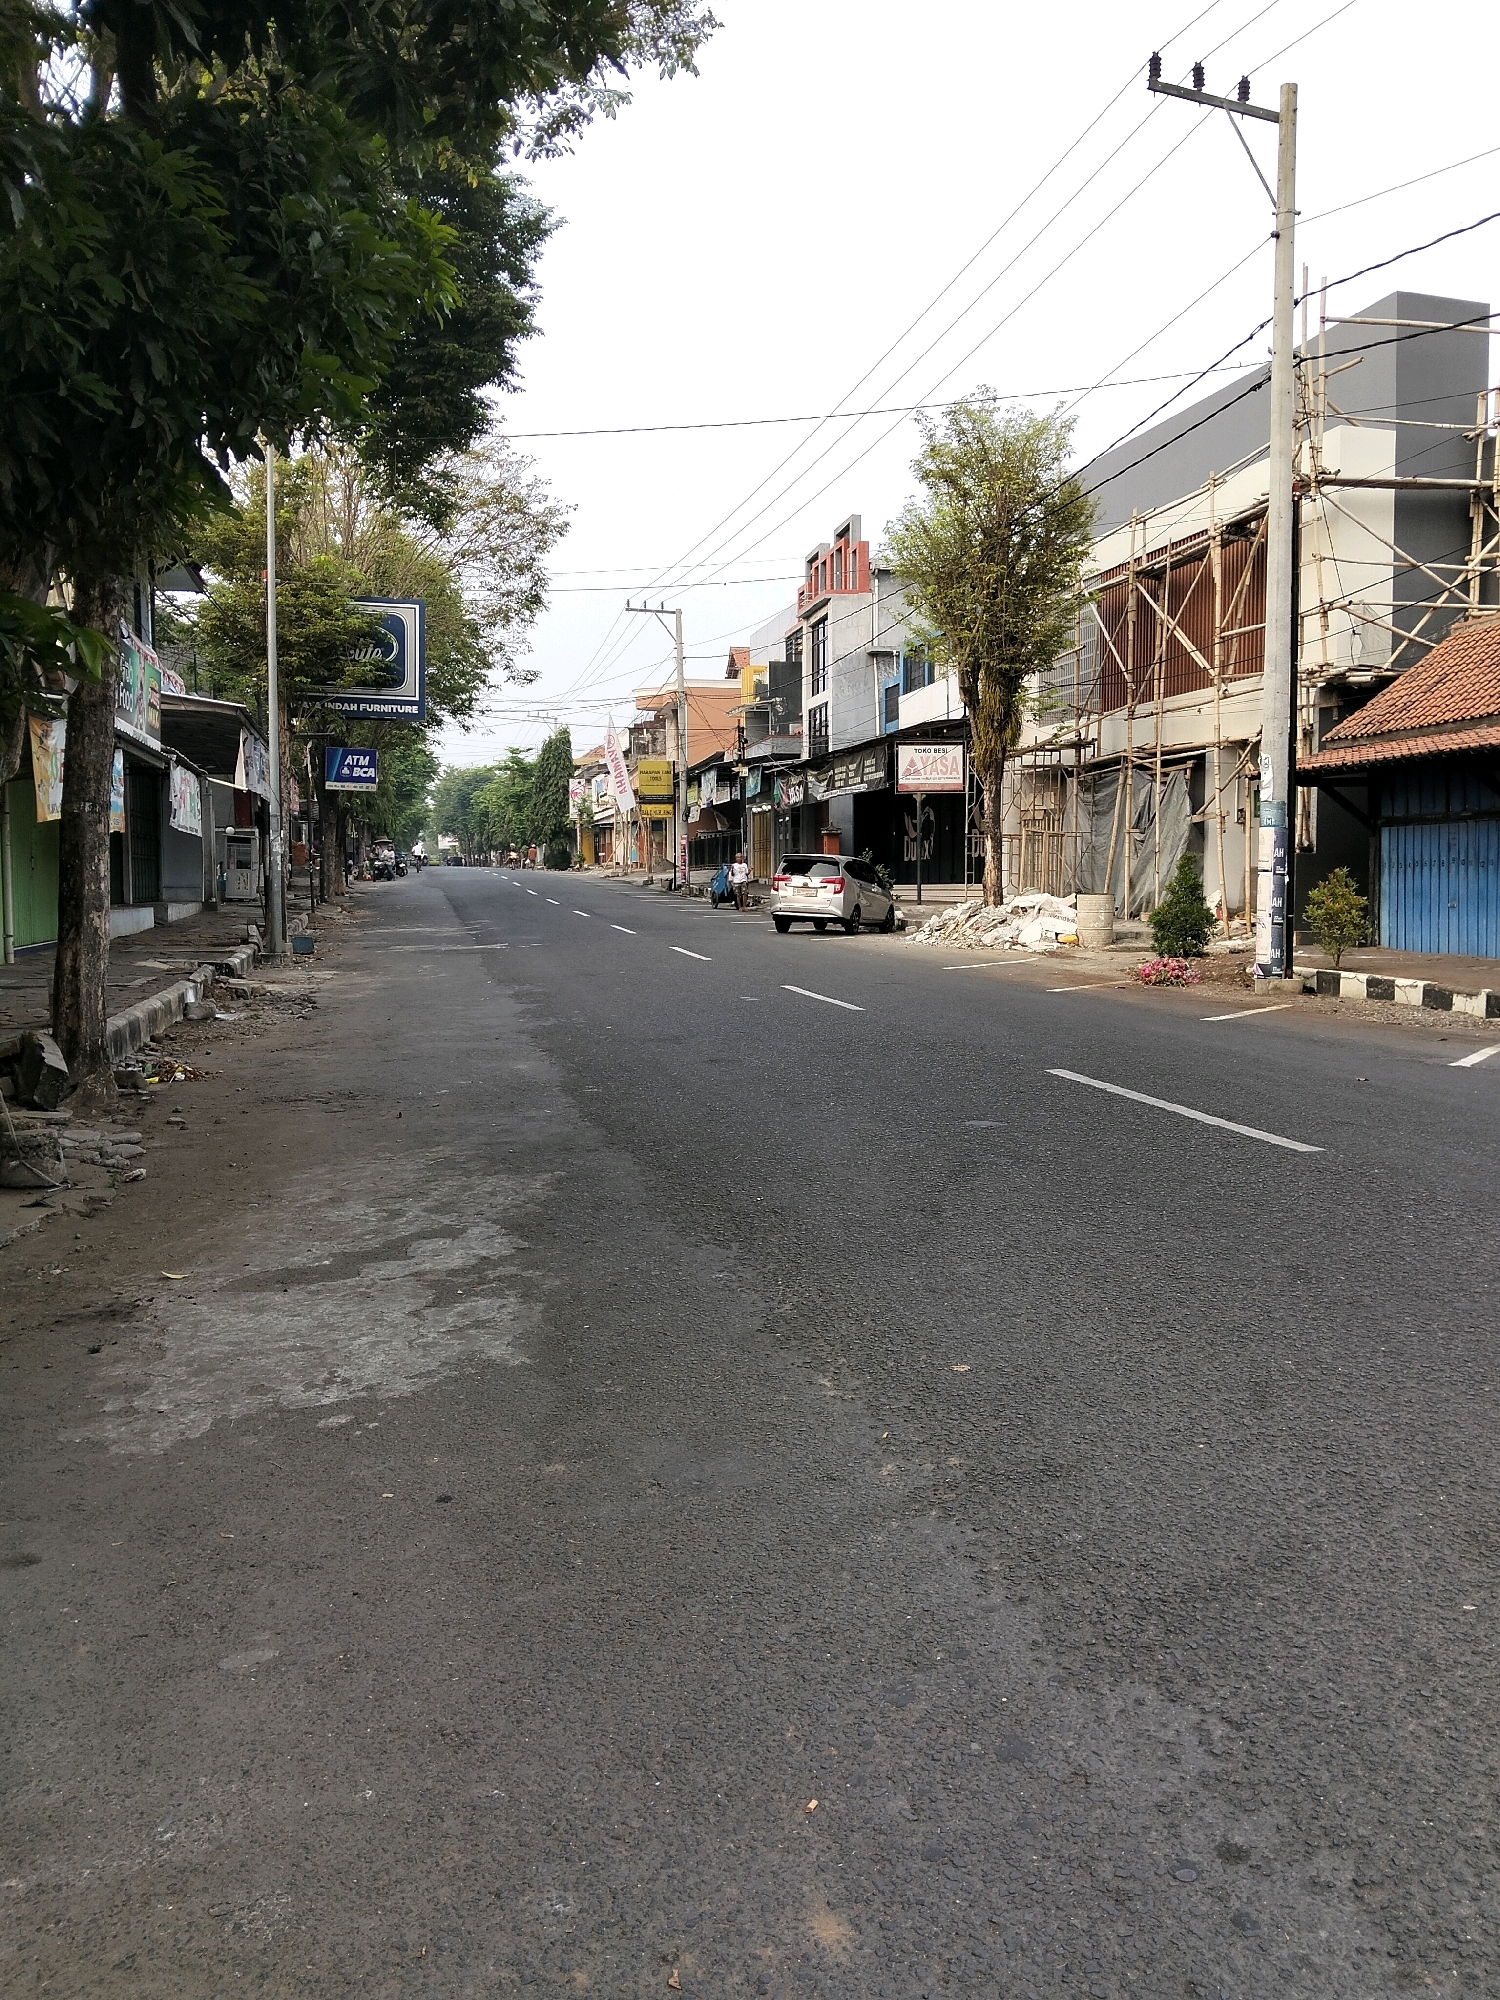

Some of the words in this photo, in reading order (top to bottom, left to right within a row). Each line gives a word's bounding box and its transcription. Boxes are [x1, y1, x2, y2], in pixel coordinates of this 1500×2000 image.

[324, 702, 358, 711] INDAH
[360, 703, 419, 714] FURNITURE
[344, 754, 370, 766] ATM
[919, 755, 960, 776] YASA
[352, 767, 376, 778] BCA
[607, 748, 628, 795] YAMAHA
